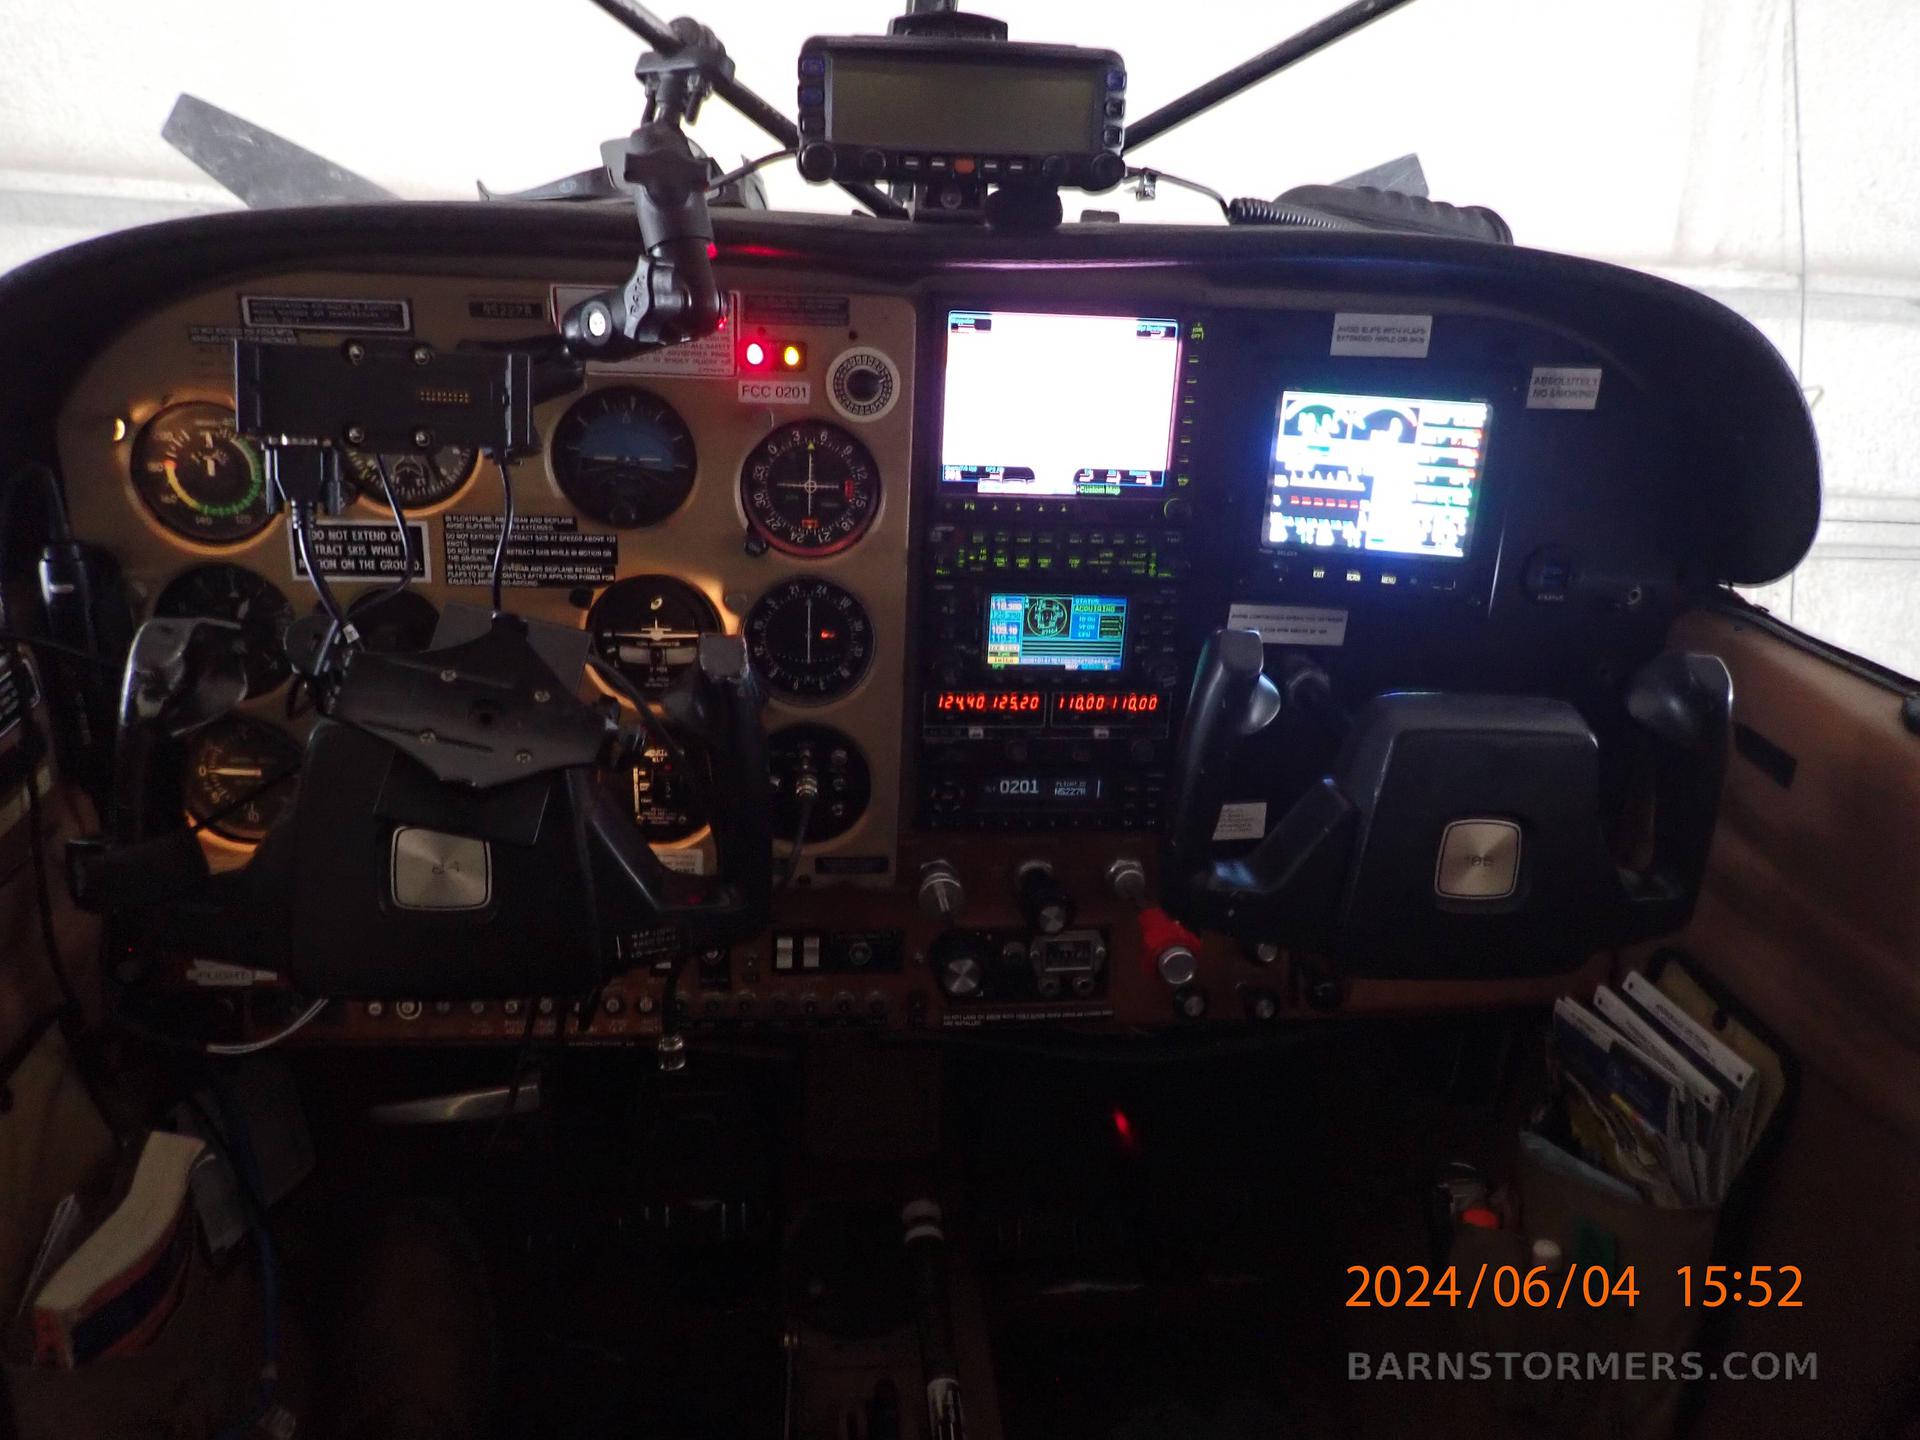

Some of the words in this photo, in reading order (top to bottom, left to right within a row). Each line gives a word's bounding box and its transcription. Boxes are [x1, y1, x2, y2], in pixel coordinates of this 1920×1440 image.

[741, 385, 771, 397] FCC
[775, 386, 807, 398] 0201
[792, 430, 800, 442] 3
[820, 431, 828, 441] 6
[1106, 486, 1121, 495] Map
[312, 530, 325, 541] DO
[329, 530, 347, 541] NOT
[353, 530, 387, 542] EXTEND
[347, 546, 367, 556] SKIS
[371, 546, 400, 556] WHILE
[341, 561, 355, 571] ON
[359, 561, 375, 571] THE
[1313, 569, 1325, 579] EXIT
[1381, 574, 1397, 585] MENU
[938, 695, 985, 711] 124.40
[992, 695, 1039, 711] 125.20
[1059, 695, 1105, 711] 110.00
[1111, 695, 1158, 711] 110.00
[1000, 779, 1040, 794] 0201
